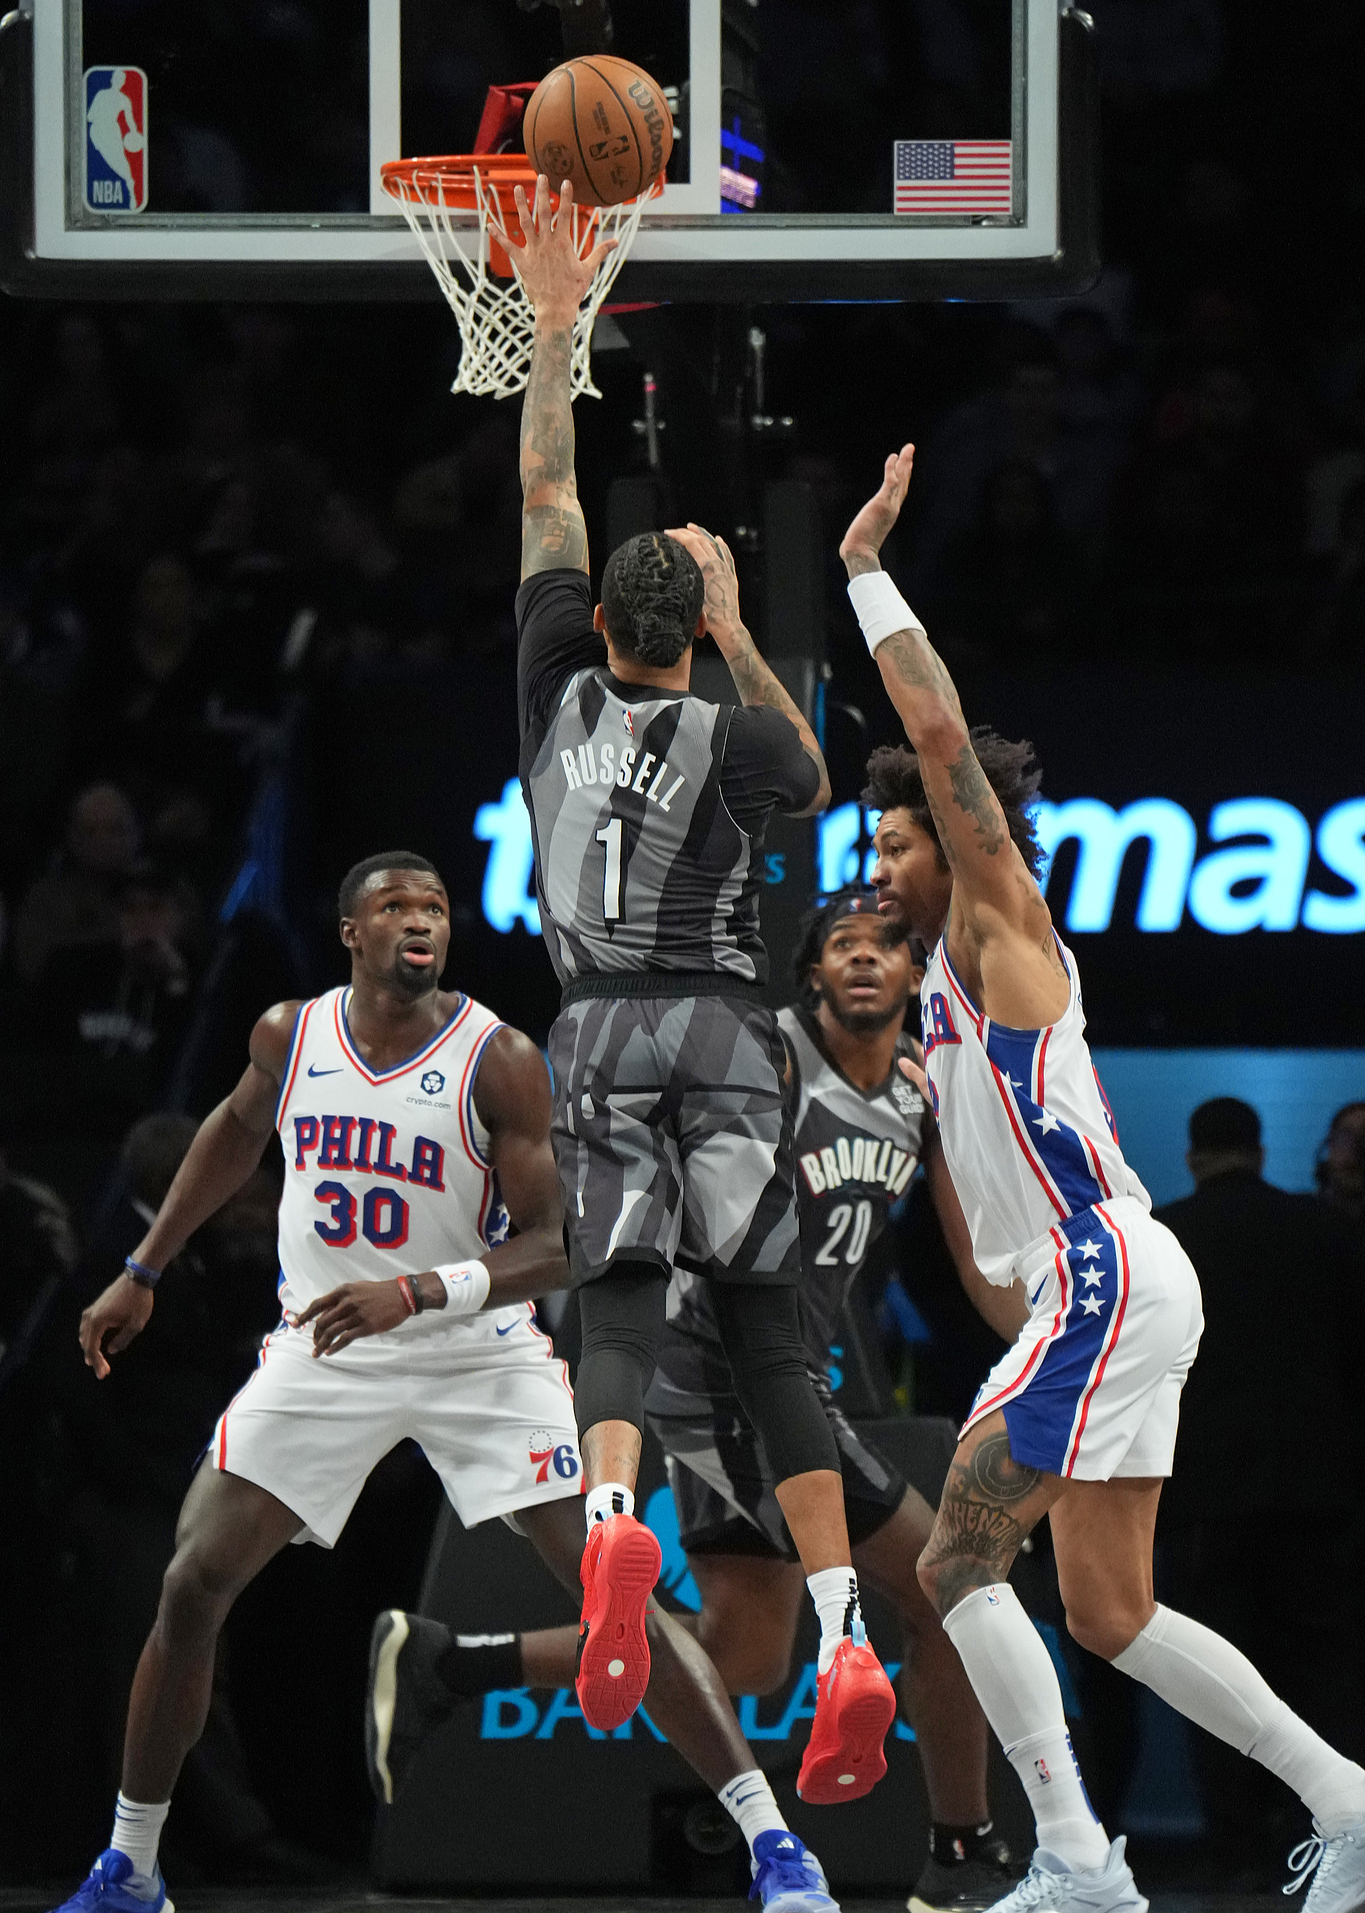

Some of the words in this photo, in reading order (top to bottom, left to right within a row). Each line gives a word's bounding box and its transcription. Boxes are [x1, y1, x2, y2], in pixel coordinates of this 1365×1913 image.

[93, 180, 123, 203] NBA
[560, 743, 686, 812] RUSSELL
[596, 817, 627, 923] 1
[406, 1097, 451, 1110] crypto.com
[294, 1115, 445, 1193] PHILA
[314, 1180, 410, 1249] 30
[815, 1201, 872, 1266] 20
[529, 1444, 578, 1486] 76
